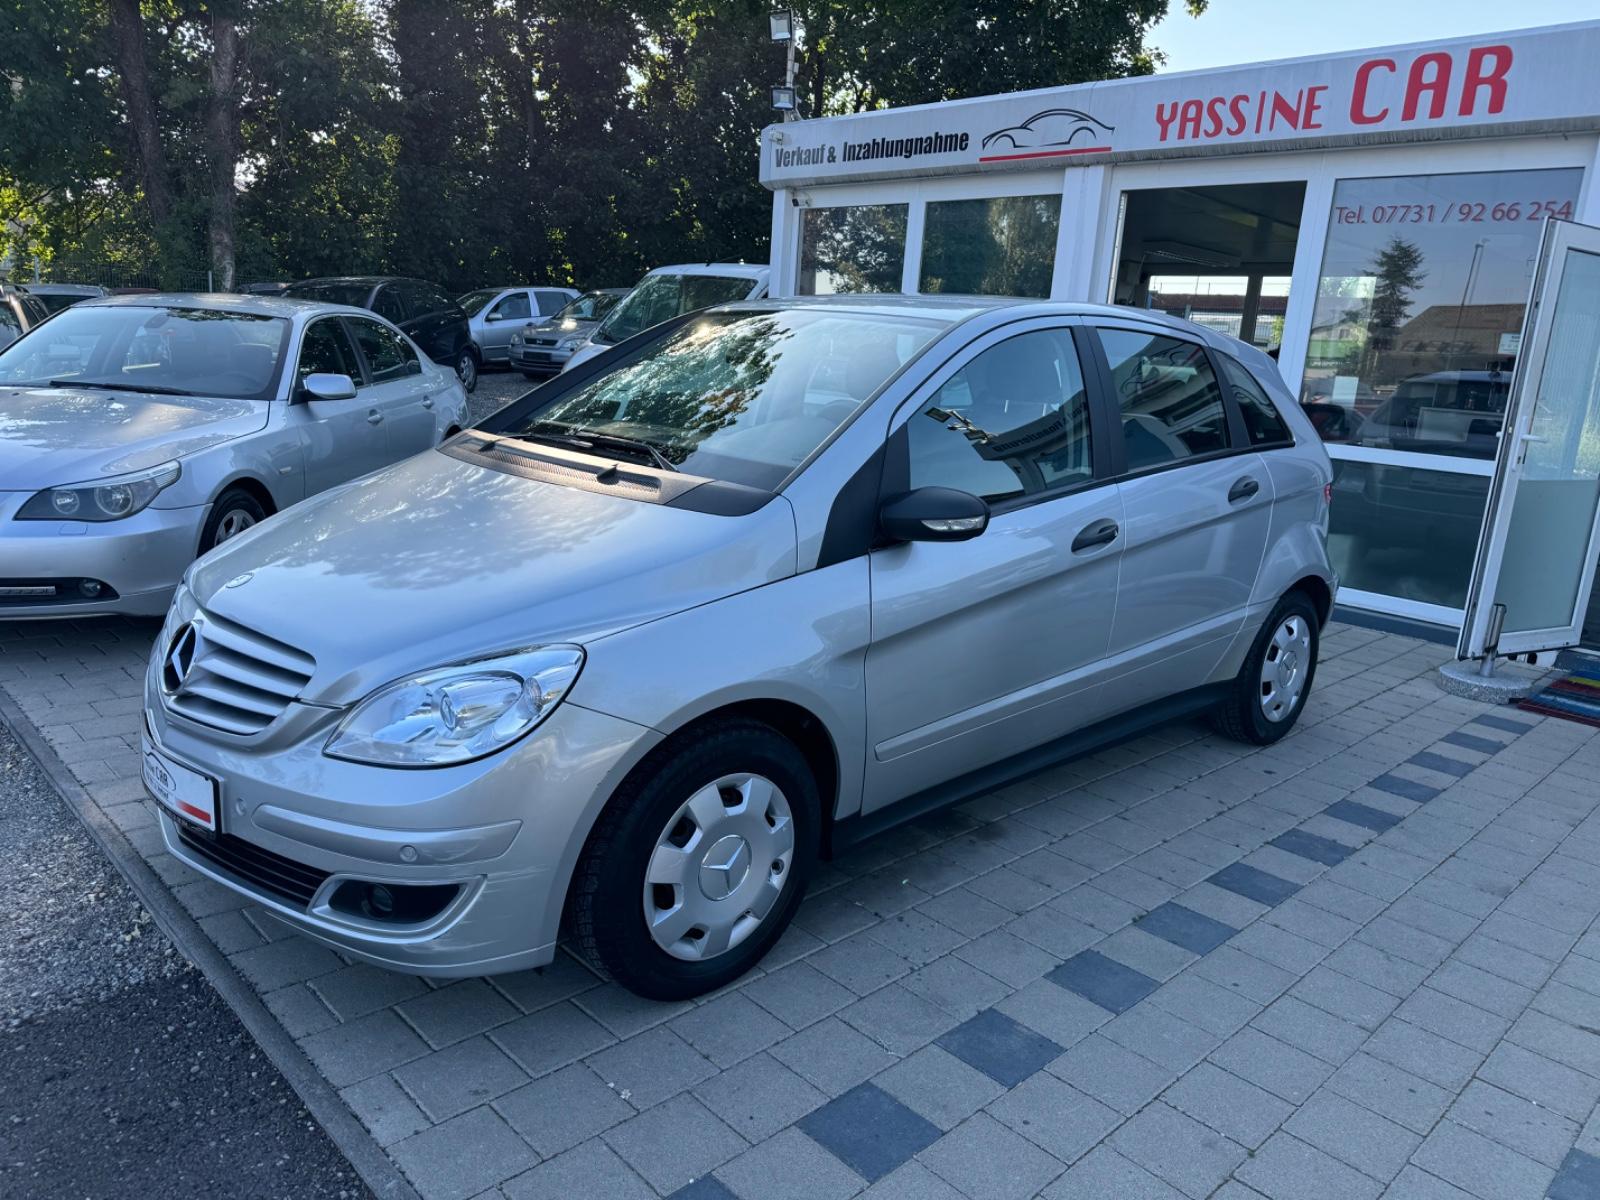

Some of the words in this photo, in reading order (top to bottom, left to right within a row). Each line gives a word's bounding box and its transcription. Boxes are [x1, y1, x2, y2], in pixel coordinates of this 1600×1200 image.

[1155, 85, 1329, 142] YASSINE
[1349, 45, 1514, 125] CAR
[775, 144, 827, 168] Verkauf
[827, 145, 837, 163] &
[842, 132, 970, 162] Inzahlungnahme
[1336, 206, 1366, 225] Tel.
[1372, 204, 1436, 224] 07731
[1441, 202, 1454, 224] /
[1458, 203, 1486, 222] 92
[1491, 202, 1521, 222] 66
[1526, 200, 1573, 222] 254
